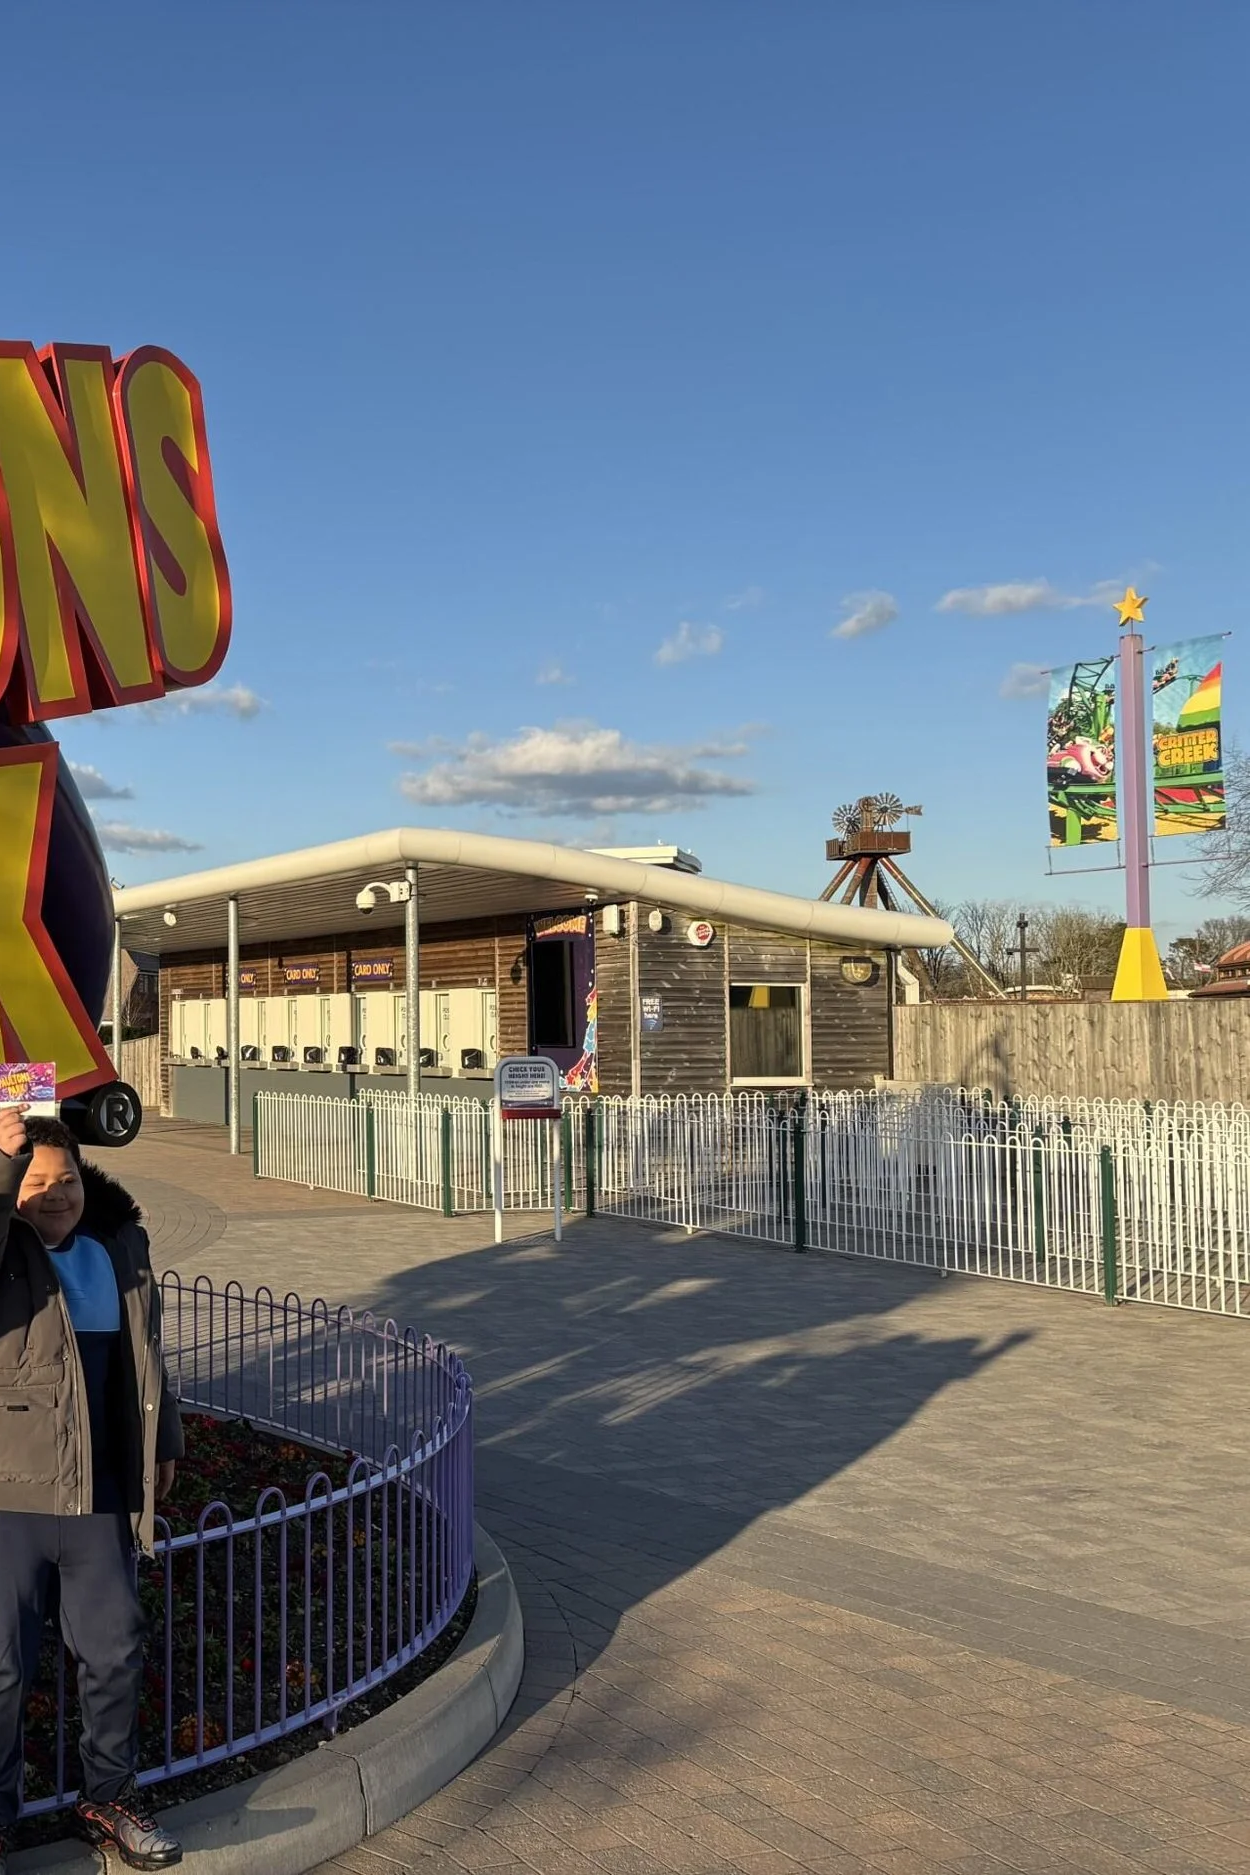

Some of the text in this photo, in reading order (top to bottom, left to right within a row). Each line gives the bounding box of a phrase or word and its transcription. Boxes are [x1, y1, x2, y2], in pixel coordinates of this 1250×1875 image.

[1157, 729, 1217, 751] CRITTER
[1157, 743, 1218, 767] CREEK
[534, 915, 587, 938] WELCOME
[286, 968, 317, 980] CARD ONLY
[354, 962, 391, 976] CARD ONLY
[241, 973, 254, 984] ONLY
[642, 998, 659, 1006] FREE
